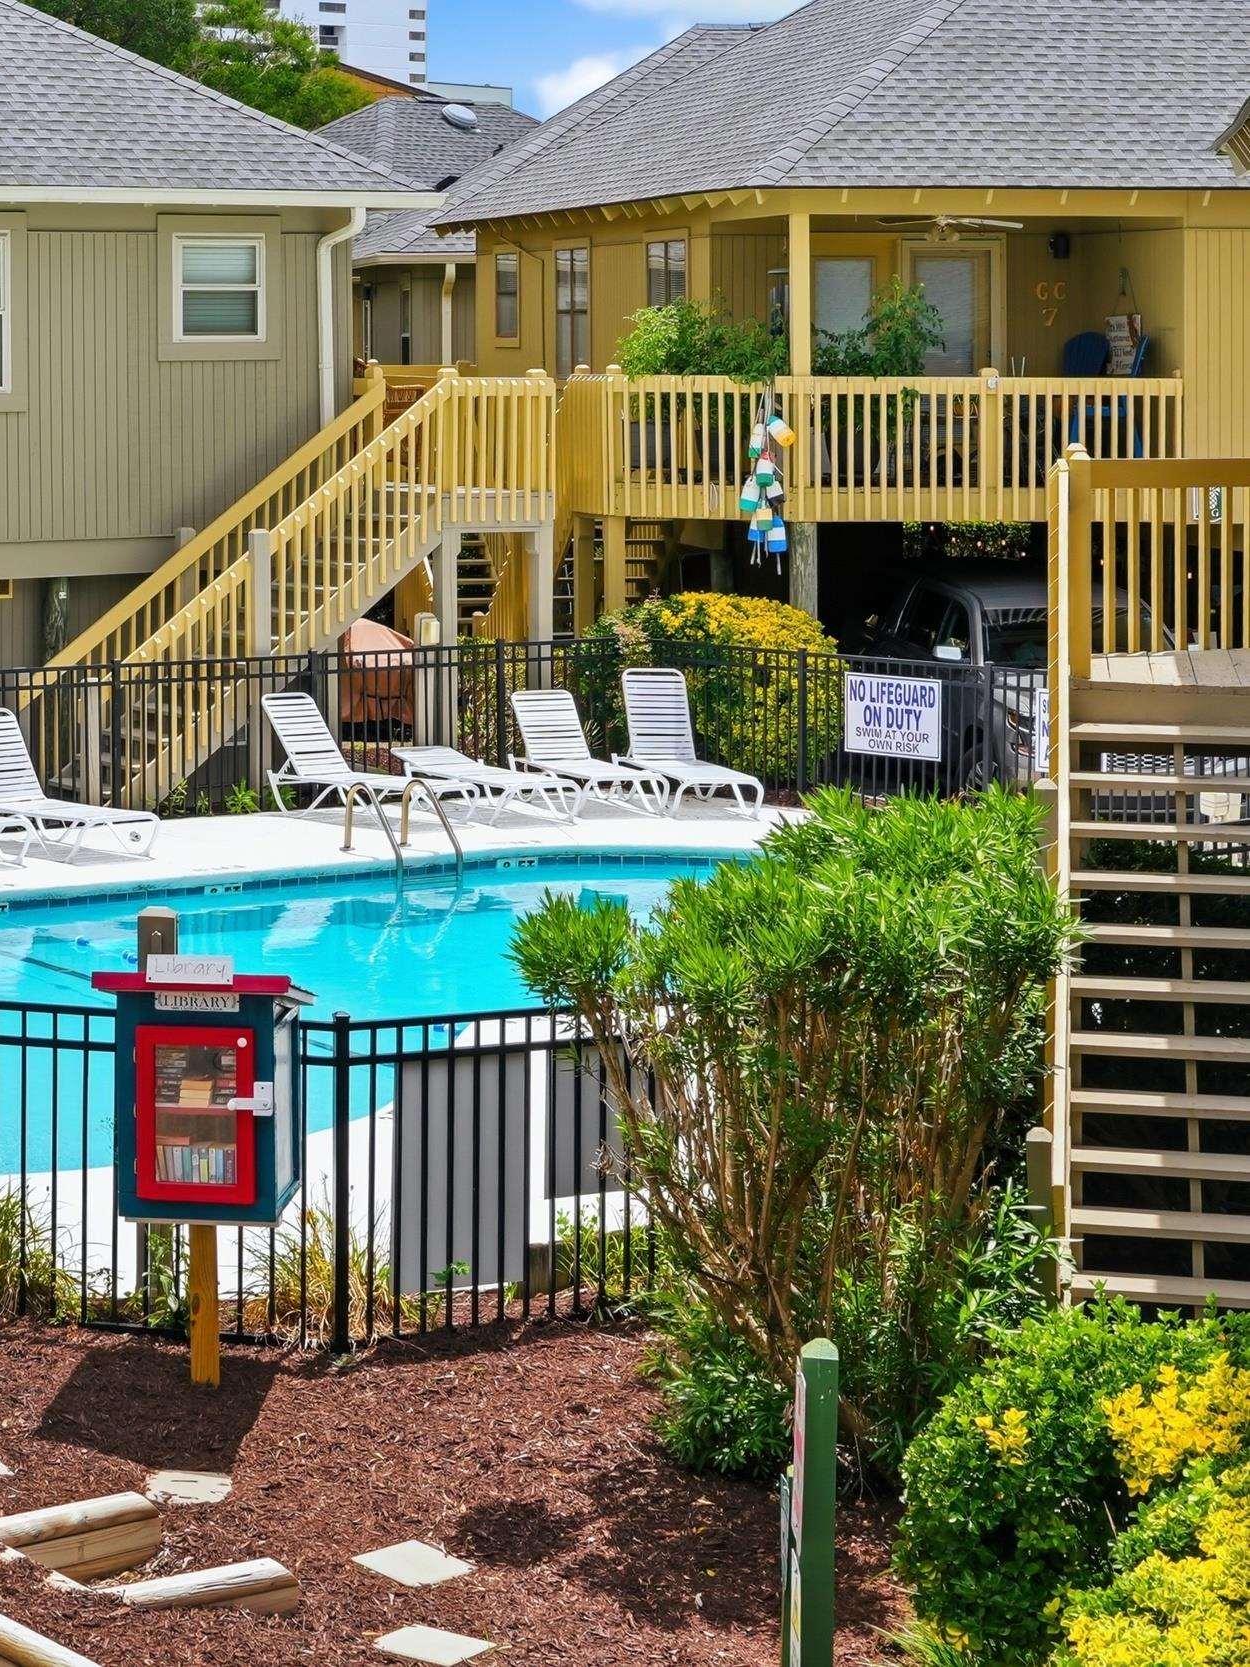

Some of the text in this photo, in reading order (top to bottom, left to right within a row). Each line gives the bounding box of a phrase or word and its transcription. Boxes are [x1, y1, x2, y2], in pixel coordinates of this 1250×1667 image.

[1042, 307, 1058, 326] 7
[850, 679, 936, 708] NO LIFEGUARD
[863, 705, 922, 731] ON DUTY
[855, 727, 929, 743] SWIM AT YOUR
[868, 739, 920, 753] OWN RISK
[155, 957, 226, 979] Library
[164, 994, 230, 1009] LIBRARY
